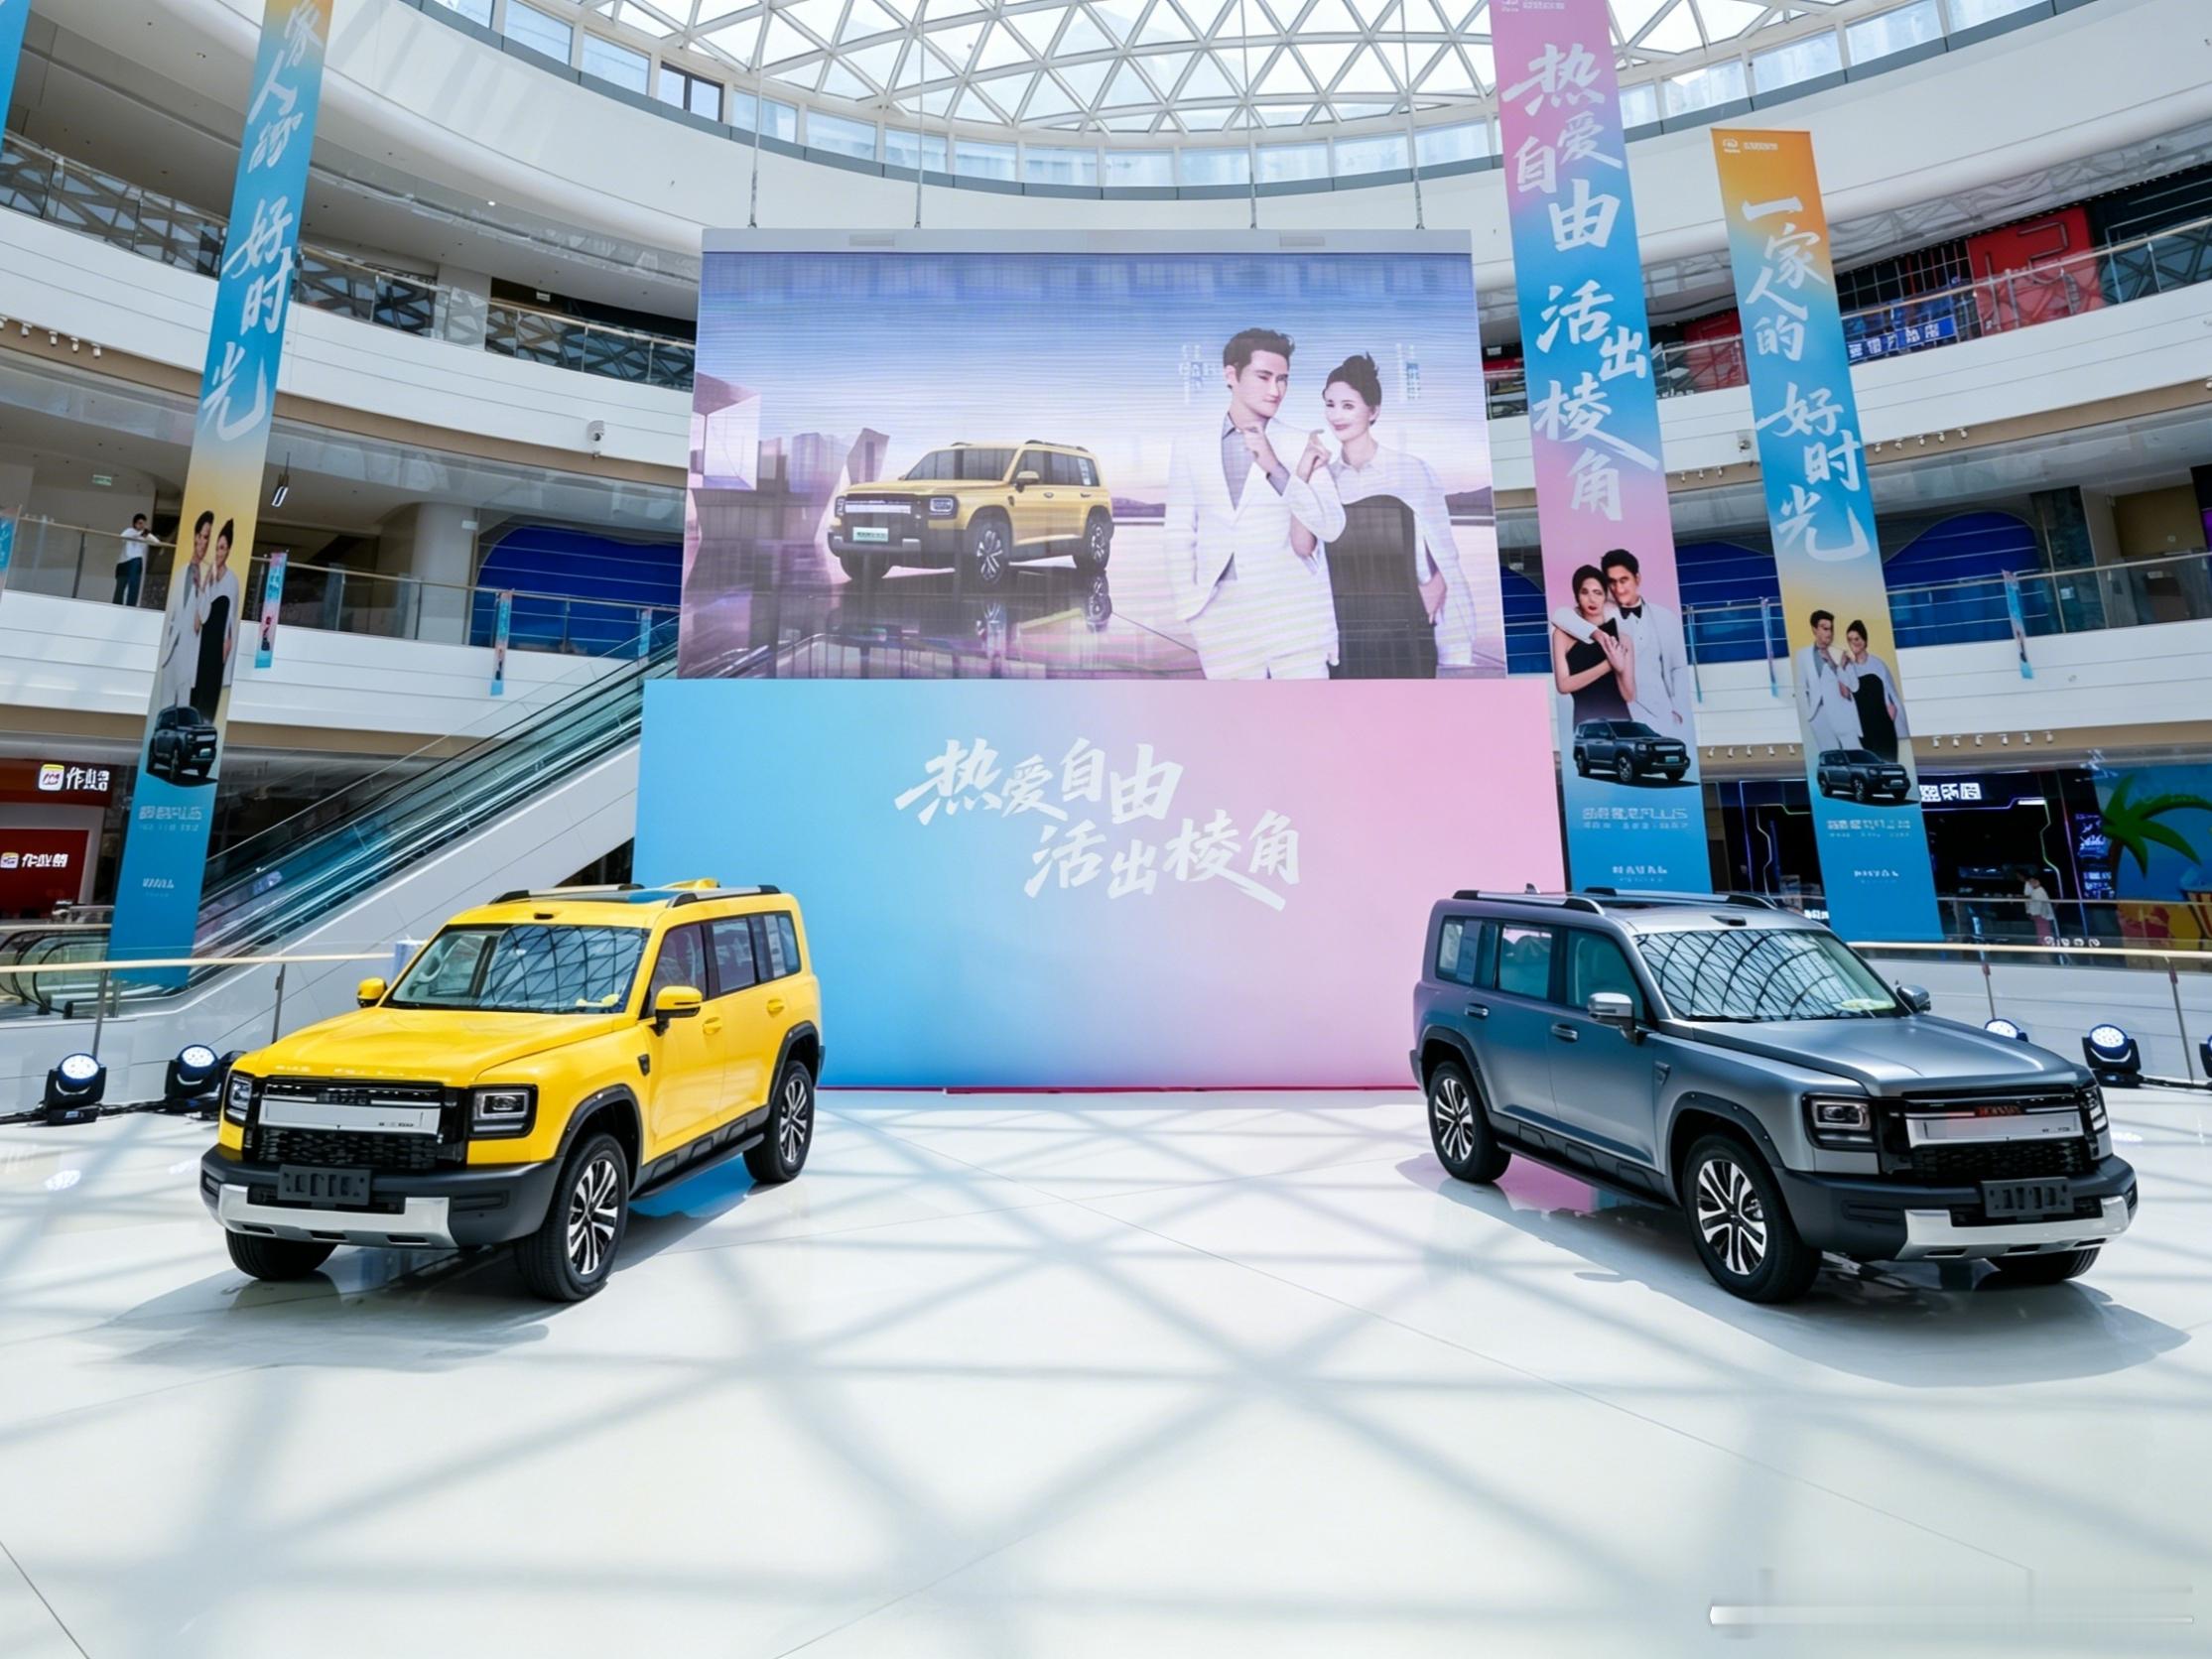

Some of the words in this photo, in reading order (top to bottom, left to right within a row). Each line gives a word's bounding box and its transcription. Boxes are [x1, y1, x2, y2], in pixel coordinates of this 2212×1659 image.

[1500, 43, 1624, 250] 热爱自由
[1532, 279, 1659, 521] 活出棱角
[894, 737, 1184, 826] 热爱自由
[1023, 809, 1300, 912] 活出棱角
